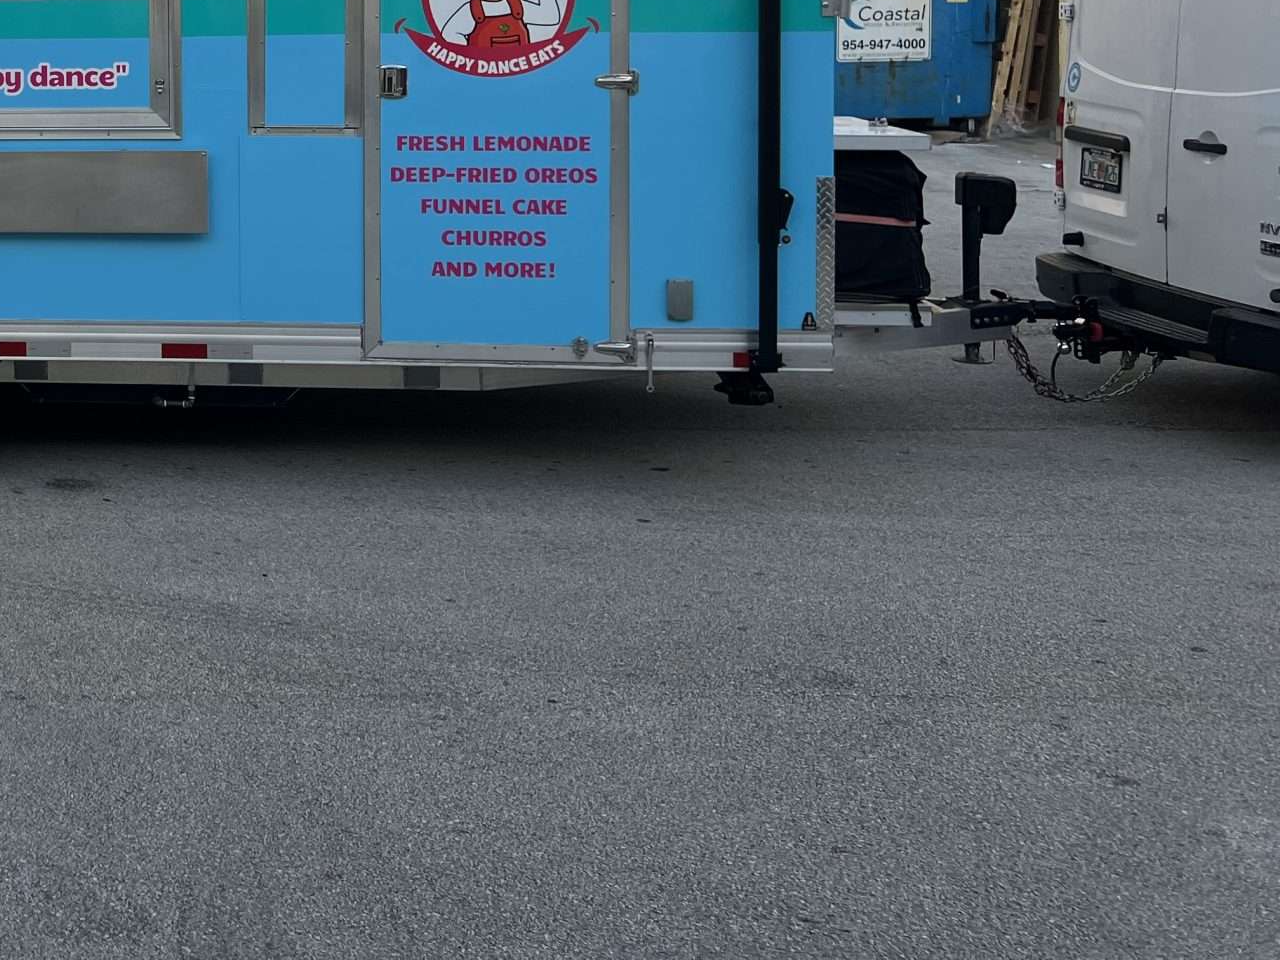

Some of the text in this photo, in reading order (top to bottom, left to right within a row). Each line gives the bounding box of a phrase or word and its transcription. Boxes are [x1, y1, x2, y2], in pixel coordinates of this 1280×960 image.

[858, 4, 926, 22] Coastal
[842, 38, 926, 50] 954-947-4000
[426, 40, 566, 75] HAPPY DANCE EATS
[28, 64, 128, 88] dance"
[396, 136, 590, 152] FRESH LEMONADE
[390, 167, 598, 184] DEEP-FRIED OREOS
[420, 198, 568, 215] FUNNEL CAKE
[441, 229, 548, 247] CHURROS
[431, 260, 556, 279] AND MORE!
